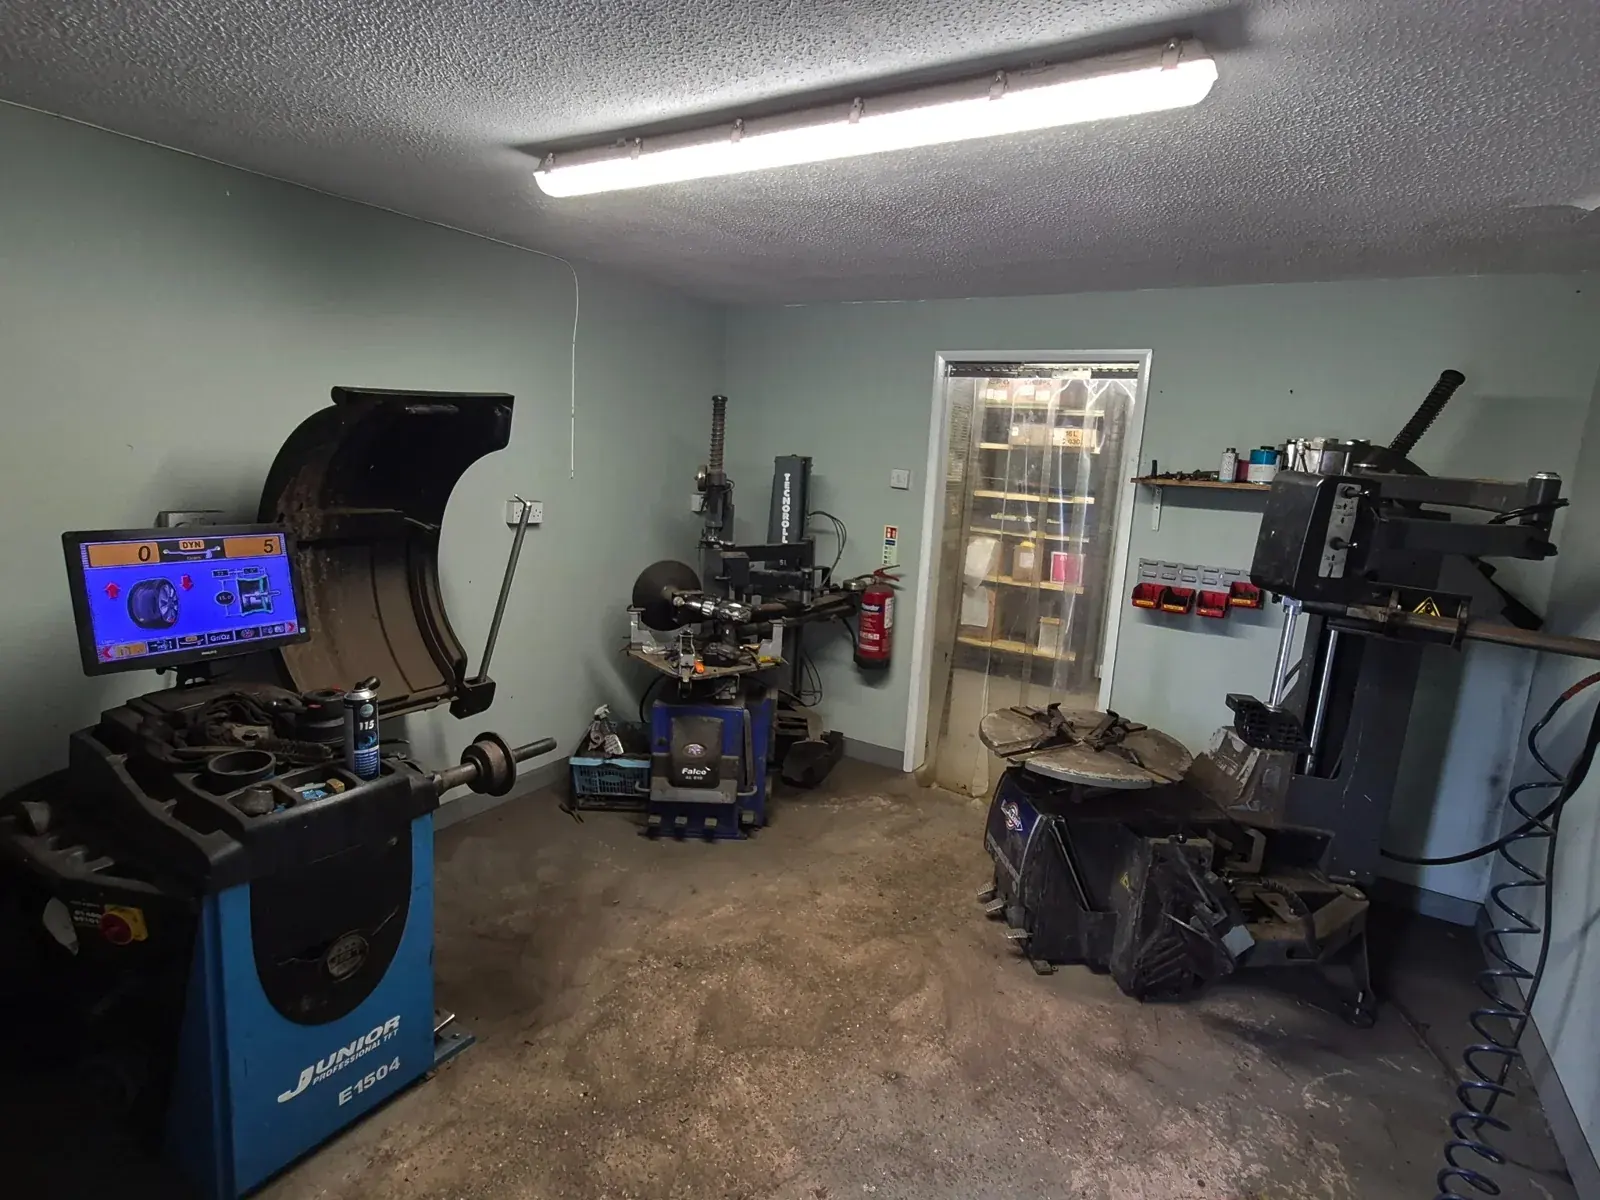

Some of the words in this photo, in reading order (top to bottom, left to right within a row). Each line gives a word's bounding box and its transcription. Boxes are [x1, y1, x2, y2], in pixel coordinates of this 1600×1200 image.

[781, 473, 791, 544] TECNOROLL
[138, 545, 152, 562] 0
[182, 541, 201, 549] DYN
[263, 538, 274, 553] 5
[359, 720, 375, 731] 115
[681, 767, 707, 775] Falco
[277, 1015, 401, 1103] JUNIOR
[312, 1041, 381, 1086] PROFESSIONAL
[383, 1029, 399, 1042] TFT
[338, 1056, 401, 1106] E1504
